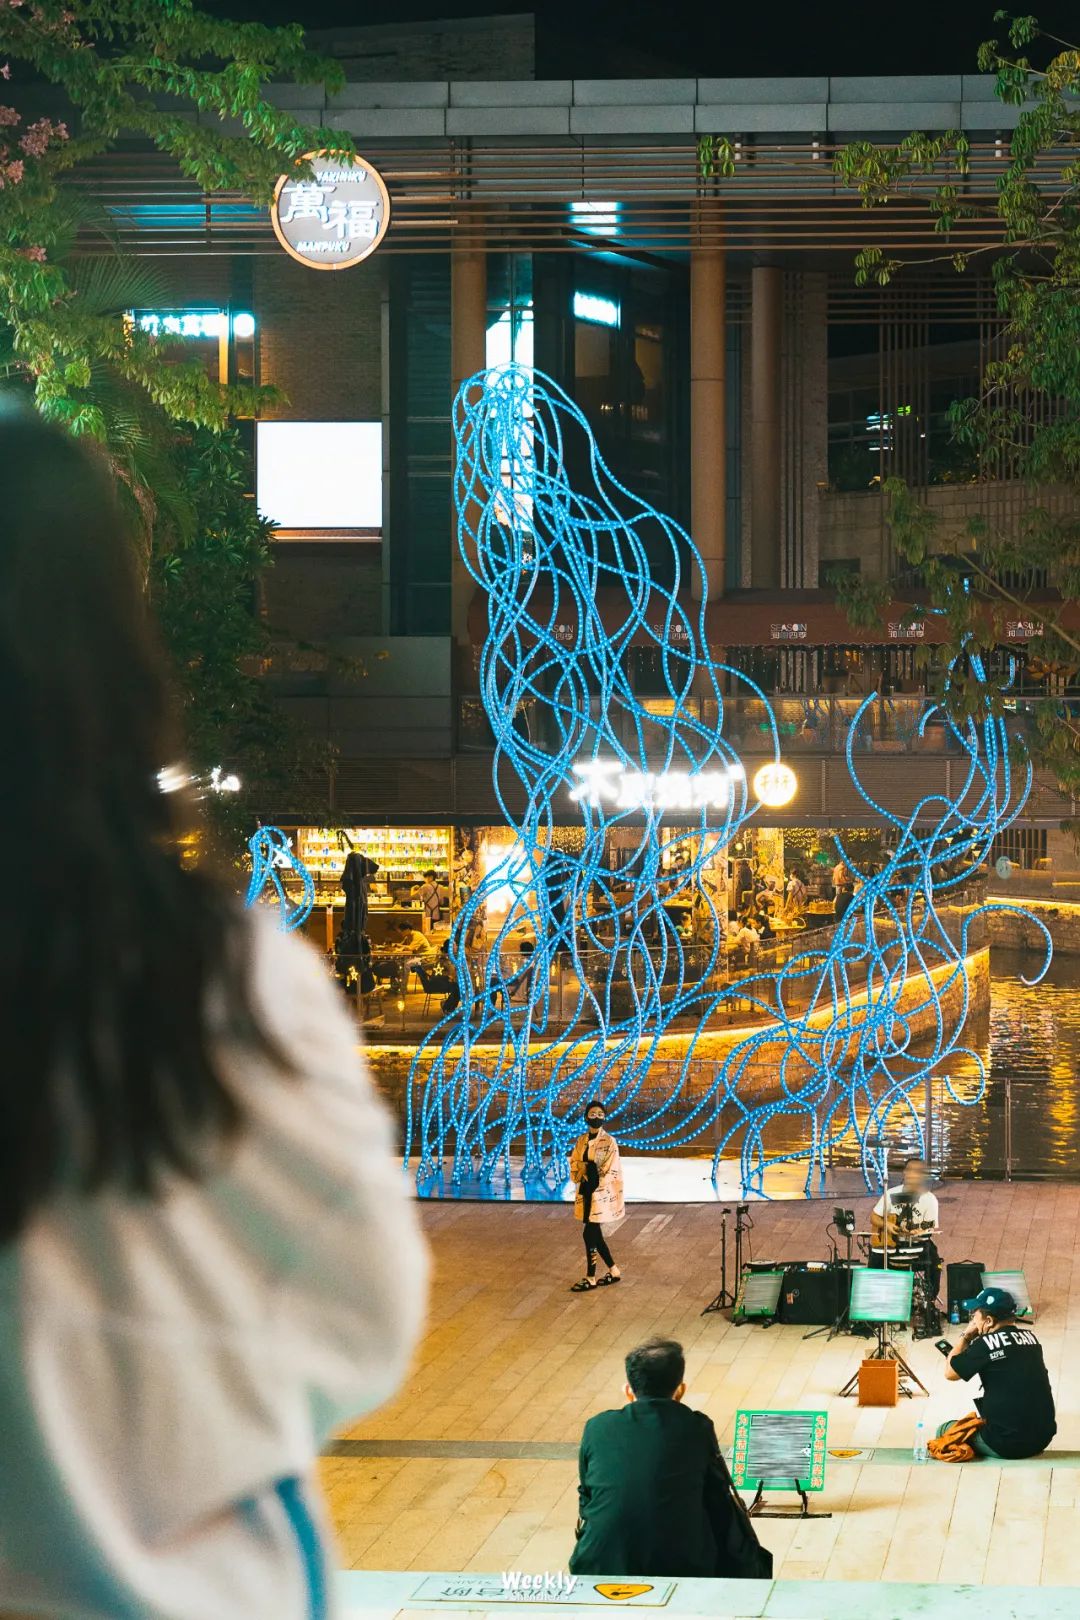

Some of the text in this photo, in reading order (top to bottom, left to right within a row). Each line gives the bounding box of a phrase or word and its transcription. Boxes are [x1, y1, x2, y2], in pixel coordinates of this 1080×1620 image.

[770, 623, 807, 631] SEASON
[982, 1330, 1037, 1350] WE CAN
